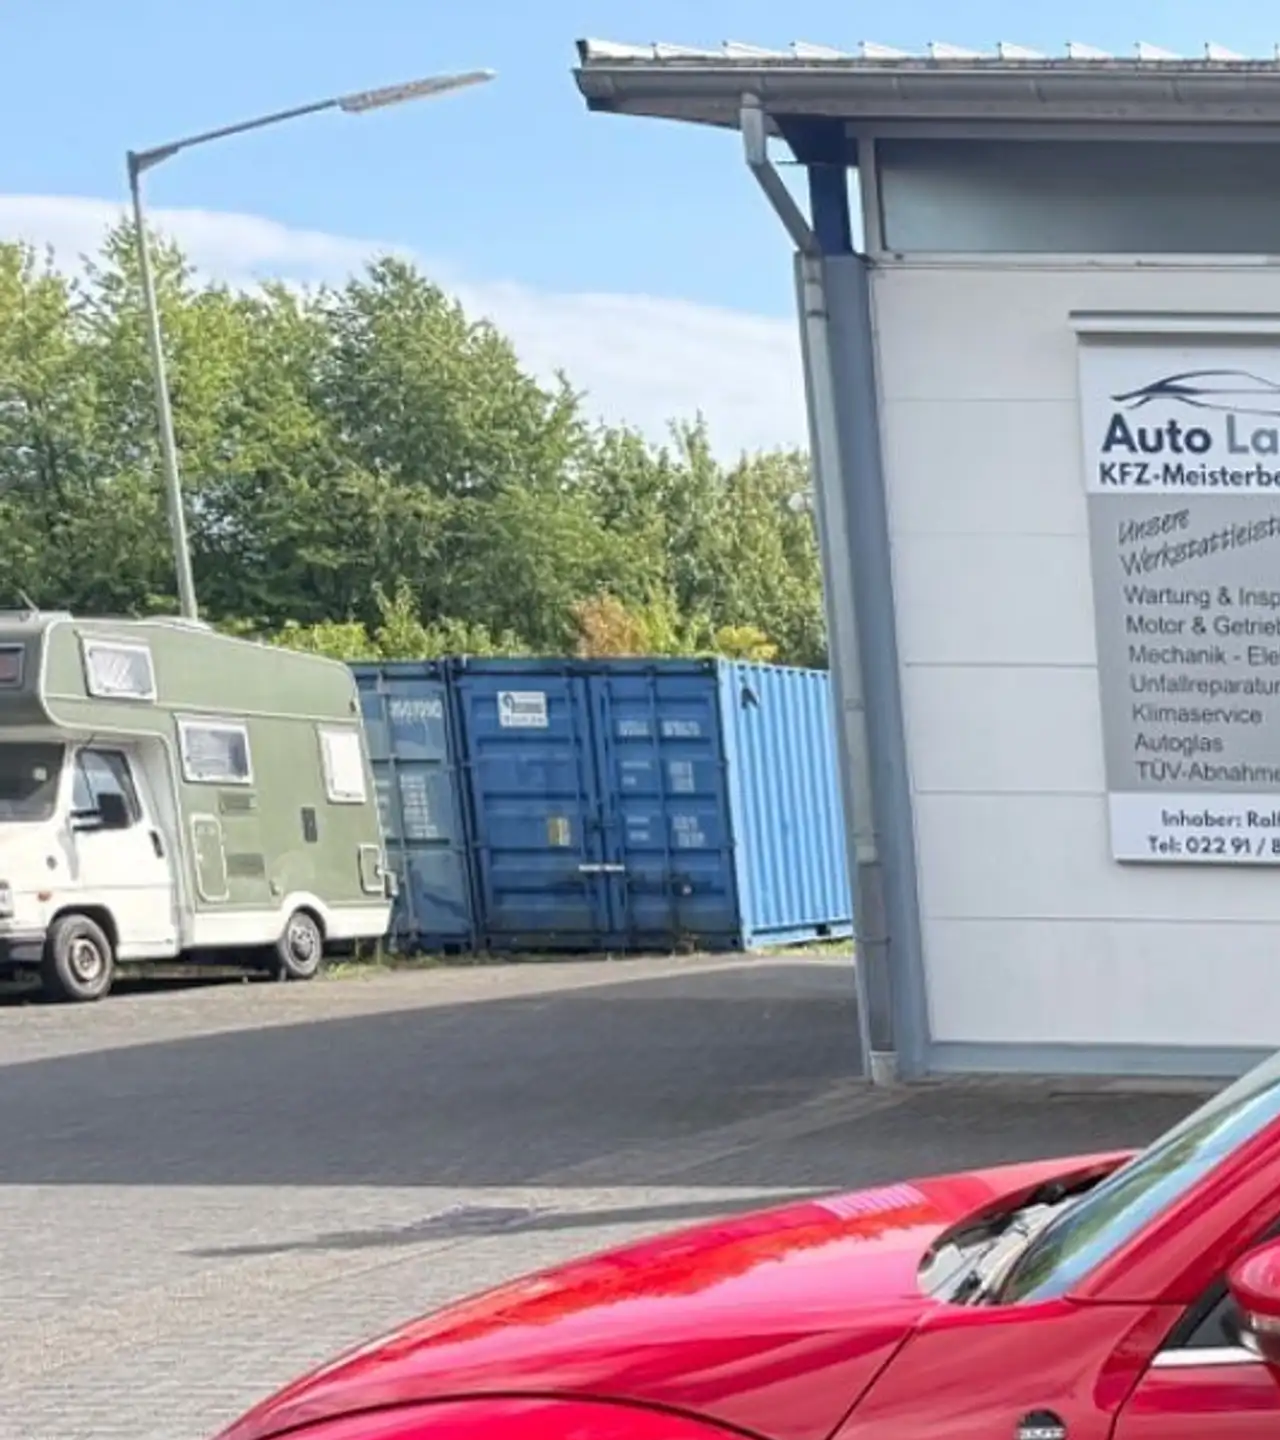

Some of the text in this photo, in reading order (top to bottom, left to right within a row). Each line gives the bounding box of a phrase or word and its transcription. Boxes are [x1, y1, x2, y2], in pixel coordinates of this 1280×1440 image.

[1101, 413, 1212, 455] Auto
[1118, 508, 1189, 546] Unsere
[1124, 586, 1211, 609] Wartung
[1218, 586, 1233, 606] &
[1126, 615, 1186, 635] Motor
[1191, 616, 1207, 635] &
[1129, 645, 1227, 665] Mechanik
[1132, 704, 1262, 725] Klimaservice
[1134, 732, 1223, 757] Autoglas
[1161, 810, 1242, 828] Inhaber:
[1186, 837, 1226, 854] 022
[1230, 838, 1250, 855] 91
[1256, 838, 1266, 856] /
